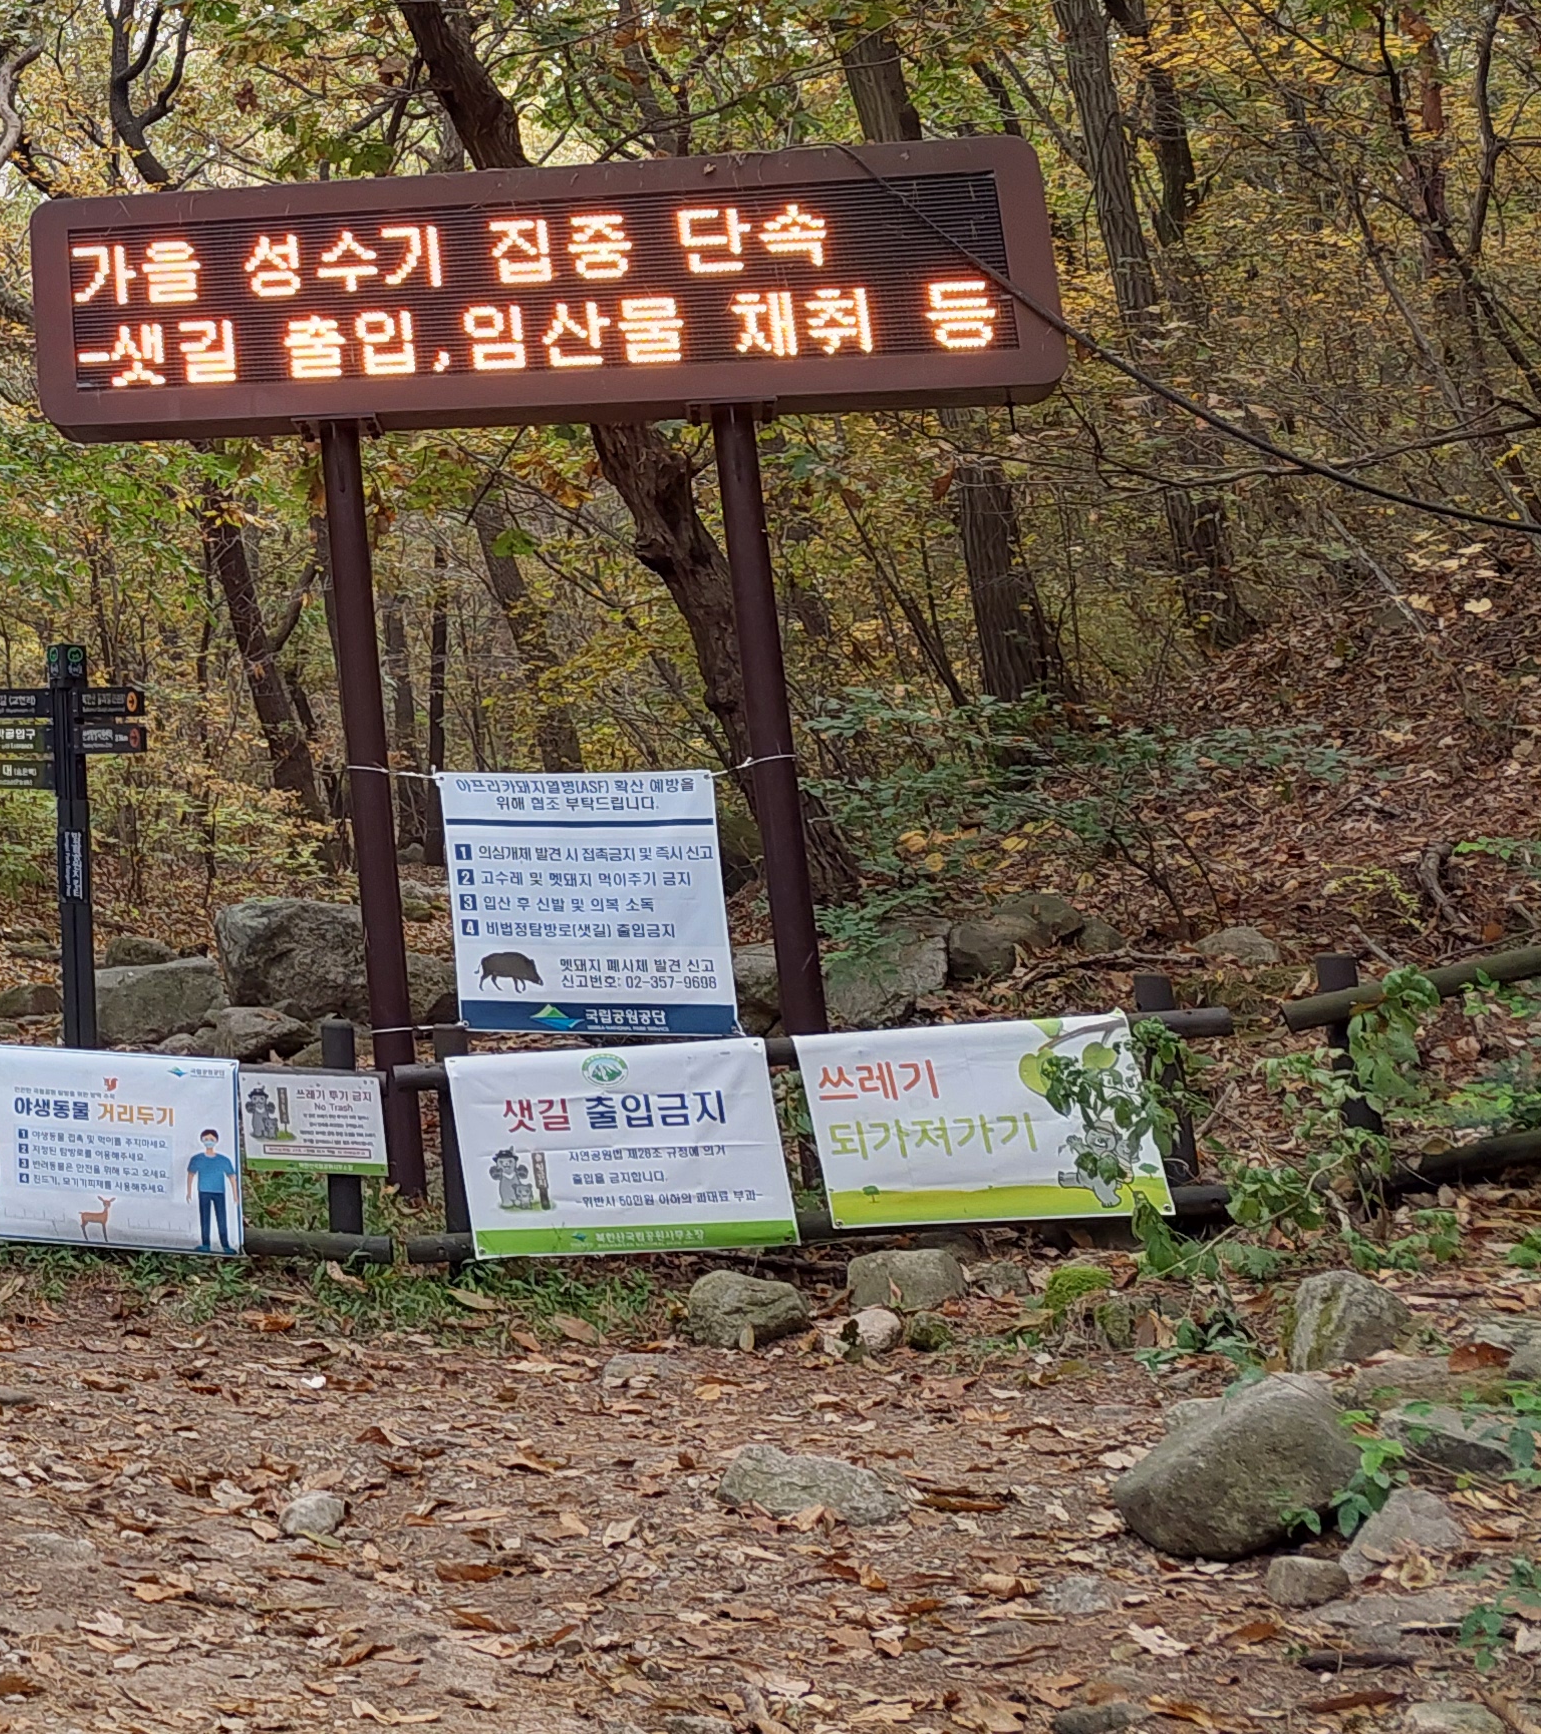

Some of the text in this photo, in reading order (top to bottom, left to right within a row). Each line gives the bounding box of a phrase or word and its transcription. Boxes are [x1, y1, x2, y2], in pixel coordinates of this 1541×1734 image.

[72, 203, 828, 306] 가을 성수기 집중 단속
[730, 287, 874, 357] 채취
[924, 280, 997, 351] 등
[455, 777, 695, 795] 아프리카돼지열병(ASF) 확산 예방을
[496, 796, 660, 812] 위해 협조 부탁드립니다.
[478, 845, 532, 861] 의심개체
[535, 847, 562, 862] 발견
[565, 848, 579, 862] 시
[581, 847, 636, 862] 접촉금지
[639, 847, 653, 861] 및
[655, 846, 683, 861] 즉시
[685, 845, 714, 860] 신고
[480, 870, 524, 886] 고수레
[529, 872, 543, 887] 및
[549, 872, 592, 888] 멧돼지
[598, 872, 657, 887] 먹이주기
[662, 871, 692, 886] 금지
[483, 896, 511, 911] 입산
[516, 897, 531, 911] 후
[536, 897, 565, 912] 신발
[571, 898, 586, 912] 및
[590, 898, 620, 912] 의복
[625, 897, 655, 912] 소독
[486, 921, 612, 938] 비법정탐방로(샛길)
[616, 923, 676, 938] 출입금지
[560, 958, 601, 973] 멧돼지
[654, 958, 682, 973] 발견
[687, 958, 715, 973] 신고
[561, 974, 621, 989] 신고번호:
[585, 1009, 667, 1025] 국립공원공단
[819, 1059, 940, 1102] 쓰레기
[296, 1089, 372, 1102] 쓰레기 투기 금지
[14, 1097, 175, 1127] 야생동물 거리두기
[314, 1102, 353, 1112] No Trash
[503, 1090, 726, 1133] 샛길 출입금지
[32, 1130, 65, 1142] 야생동물
[67, 1133, 84, 1144] 접촉
[86, 1135, 95, 1144] 및
[97, 1136, 121, 1146] 먹이를
[829, 1112, 1038, 1160] 되가져가기
[32, 1145, 57, 1156] 지정된
[60, 1147, 92, 1159] 탐방로를
[95, 1150, 146, 1162] 이용해주세요.
[569, 1145, 726, 1162] 자연공원법 제28조 규정에 의거
[32, 1160, 74, 1172] 반려동물은
[76, 1163, 101, 1174] 안전을
[104, 1166, 120, 1176] 위해
[123, 1168, 139, 1176] 두고
[33, 1175, 60, 1186] 진드기,
[63, 1177, 112, 1190] 모기기피제를
[572, 1173, 605, 1185] 출입을
[619, 1193, 654, 1207] 50만원
[659, 1192, 692, 1205] 이하의
[697, 1191, 729, 1203] 과태료
[595, 1228, 704, 1244] 북한산국립공원사무소장
